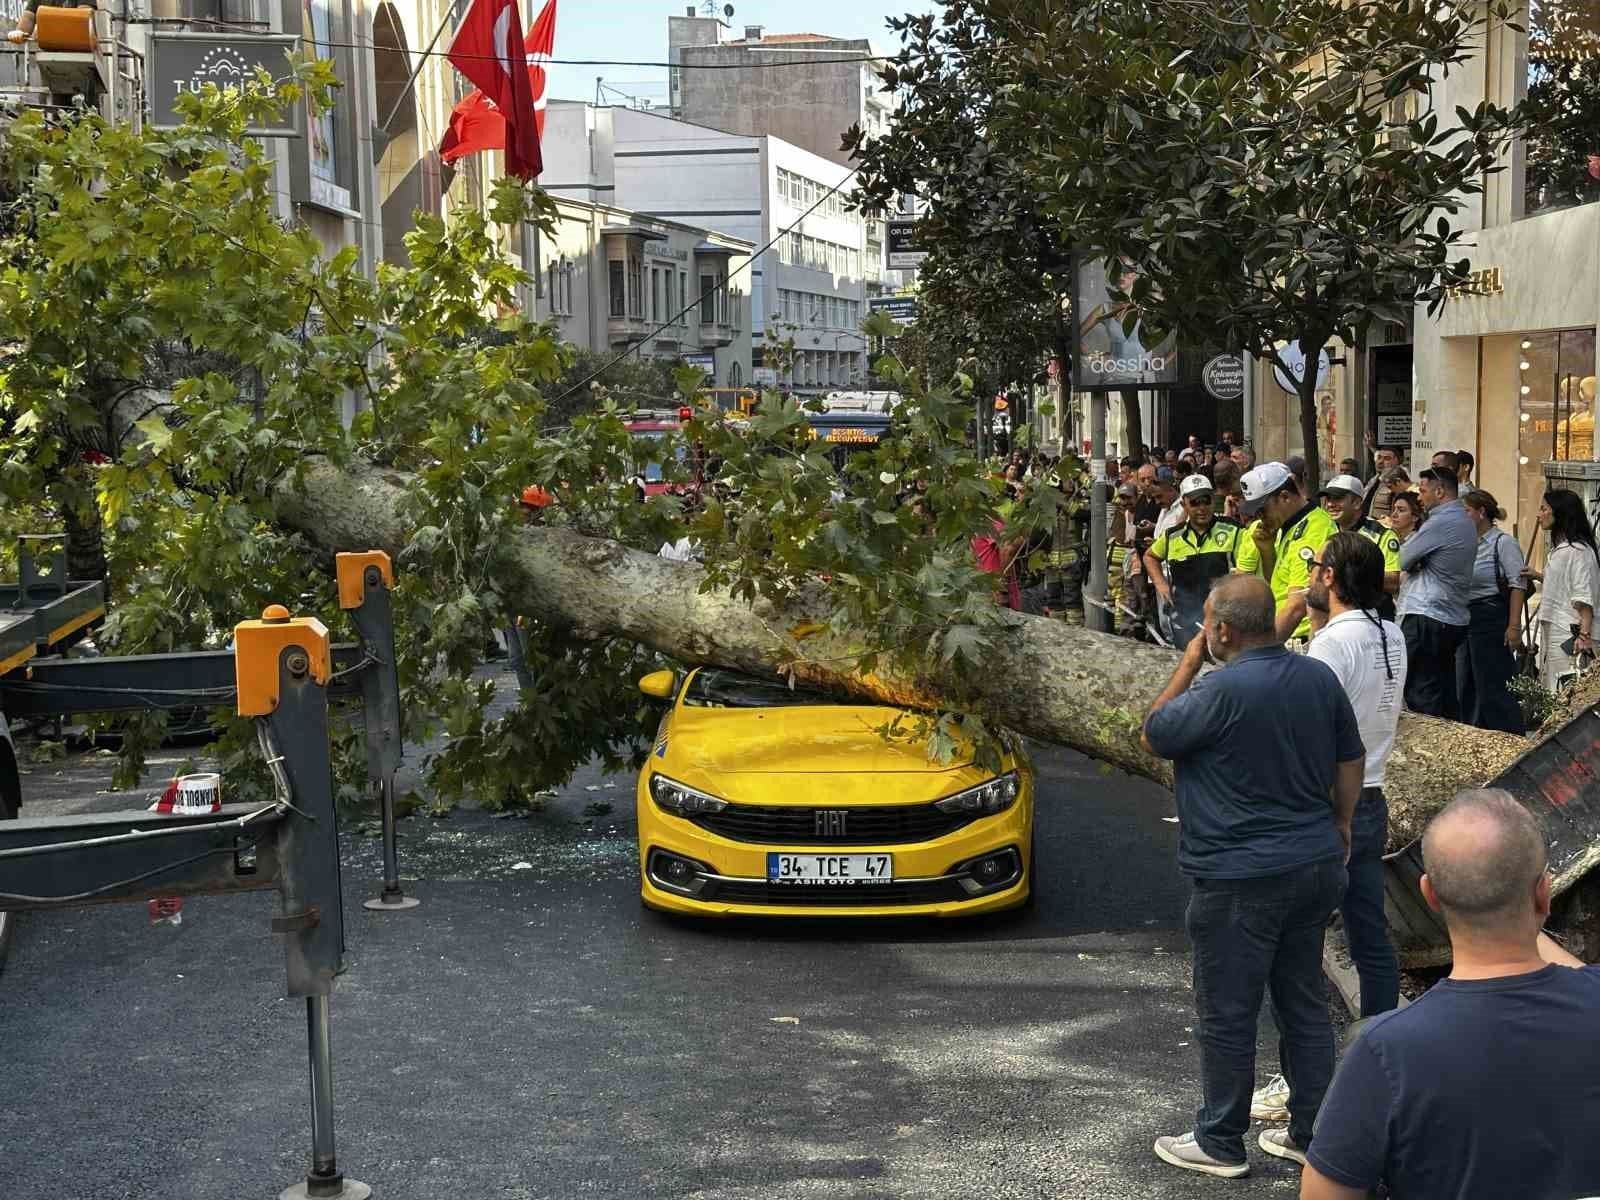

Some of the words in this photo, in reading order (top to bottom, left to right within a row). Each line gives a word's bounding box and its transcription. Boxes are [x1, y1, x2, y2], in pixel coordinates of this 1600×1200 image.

[1090, 352, 1166, 374] dossha
[815, 810, 849, 836] FIAT
[780, 857, 803, 877] 34
[815, 857, 850, 877] TCE
[865, 857, 888, 877] 47
